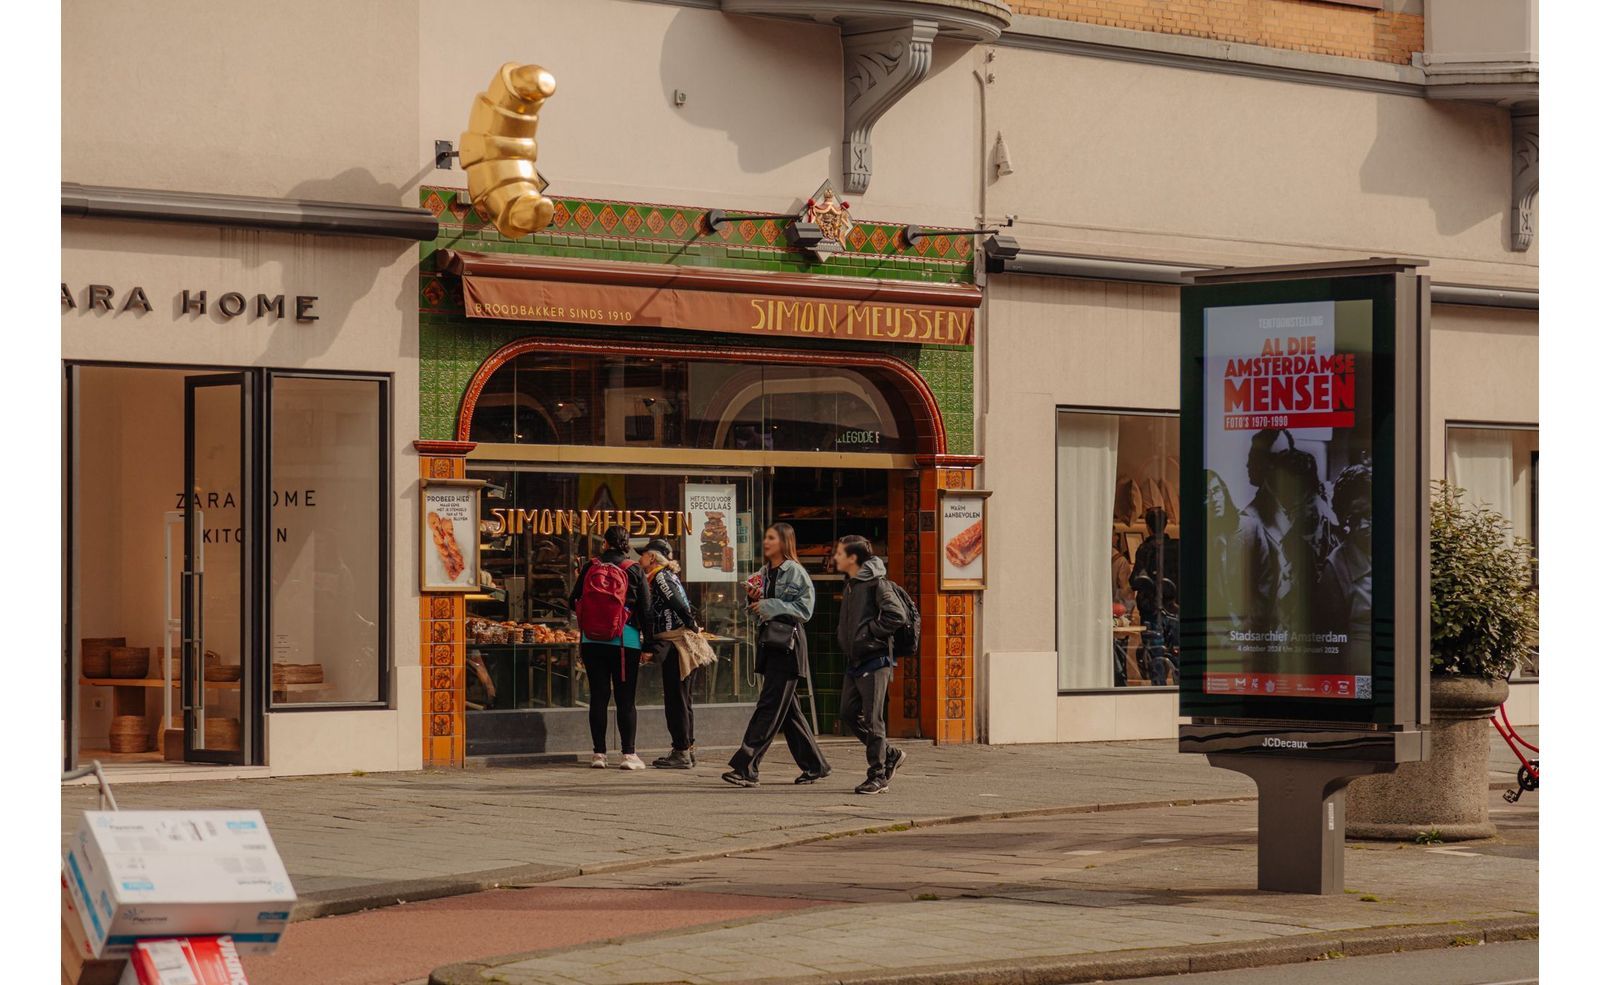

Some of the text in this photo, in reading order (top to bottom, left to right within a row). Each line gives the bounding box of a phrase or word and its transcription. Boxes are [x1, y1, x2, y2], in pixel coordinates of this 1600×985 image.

[182, 290, 319, 320] HOME
[475, 303, 632, 321] BROODBAKKER SINDS 1910
[751, 299, 837, 334] SIMON
[1259, 316, 1323, 328] TENTOONSTELLING
[1261, 336, 1316, 357] AL DIE
[1224, 354, 1355, 377] AMSTERDAMSE
[1224, 374, 1355, 412] MENSEN
[1226, 415, 1288, 428] FOTO'S 1970-1990
[690, 502, 731, 511] SPECULAAS
[490, 508, 573, 536] SIMON
[203, 528, 287, 543] KITCN
[1230, 630, 1347, 643] Stadsarchief Amsterdam
[1262, 737, 1308, 749] JCDecaux
